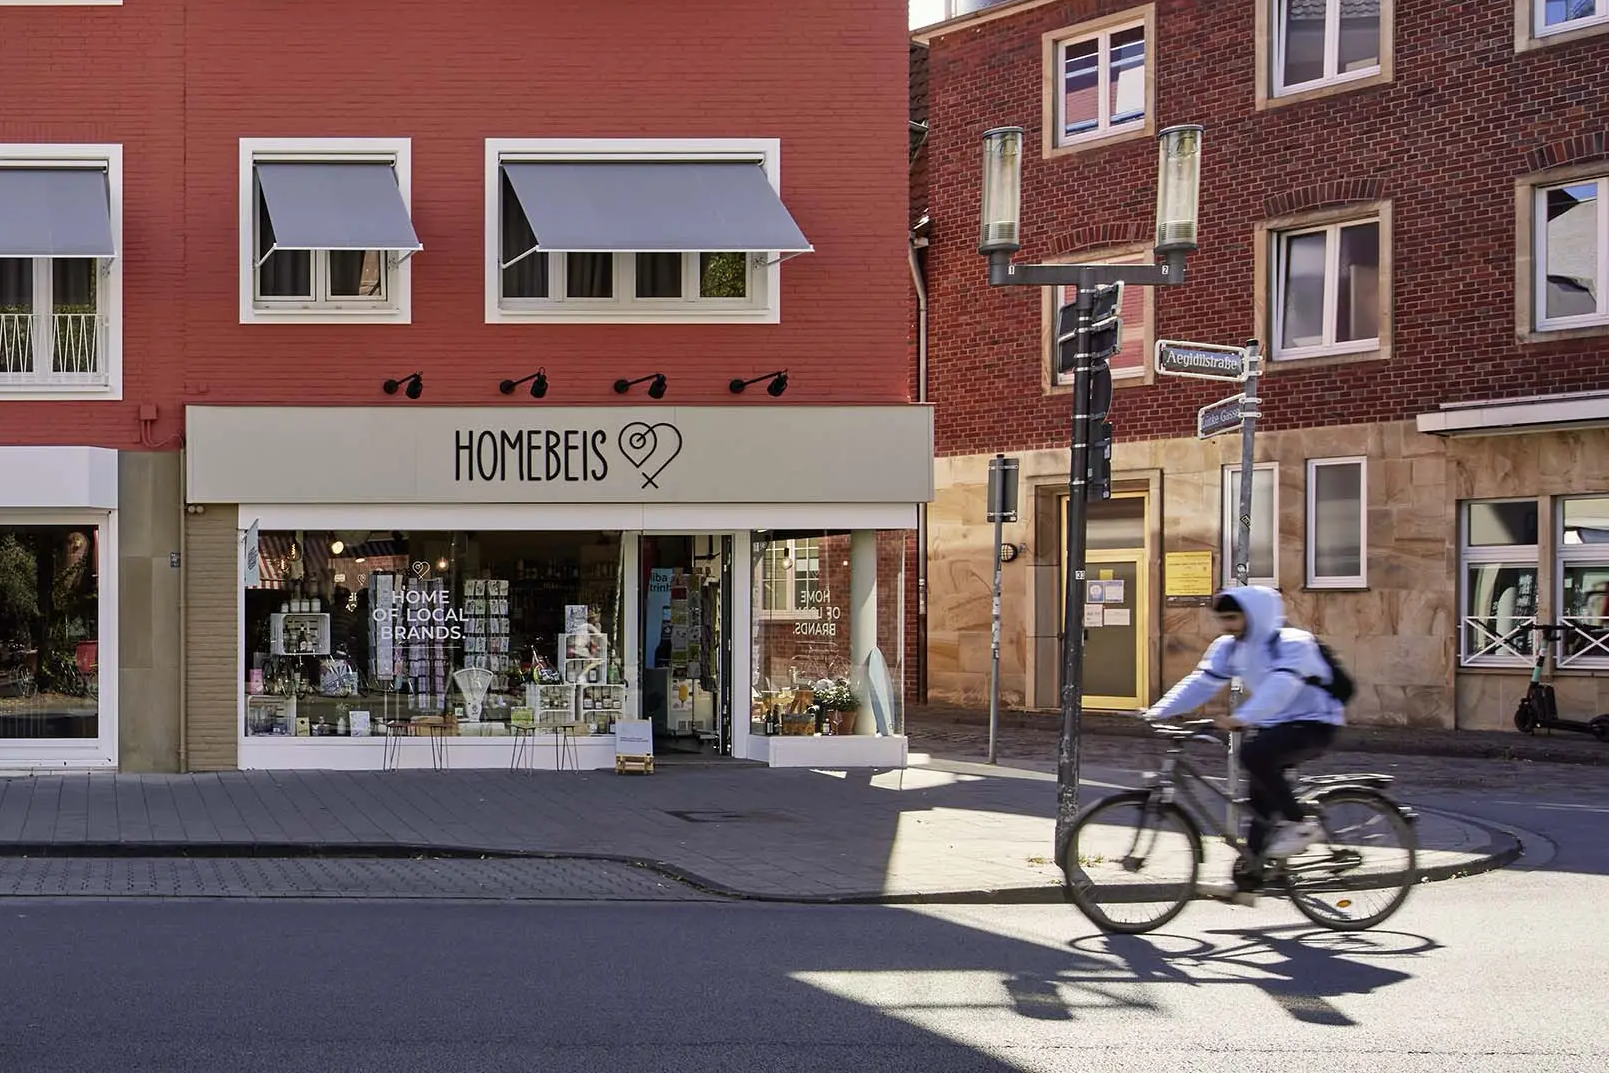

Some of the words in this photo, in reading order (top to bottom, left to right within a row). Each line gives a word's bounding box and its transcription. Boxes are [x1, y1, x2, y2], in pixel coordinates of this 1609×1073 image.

[1166, 350, 1238, 370] Aegidiistraße
[455, 429, 609, 482] HOMEBEIS
[392, 590, 450, 604] HOME
[372, 608, 399, 622] OF
[406, 608, 470, 622] LOCAL
[381, 626, 467, 640] BRANDS.
